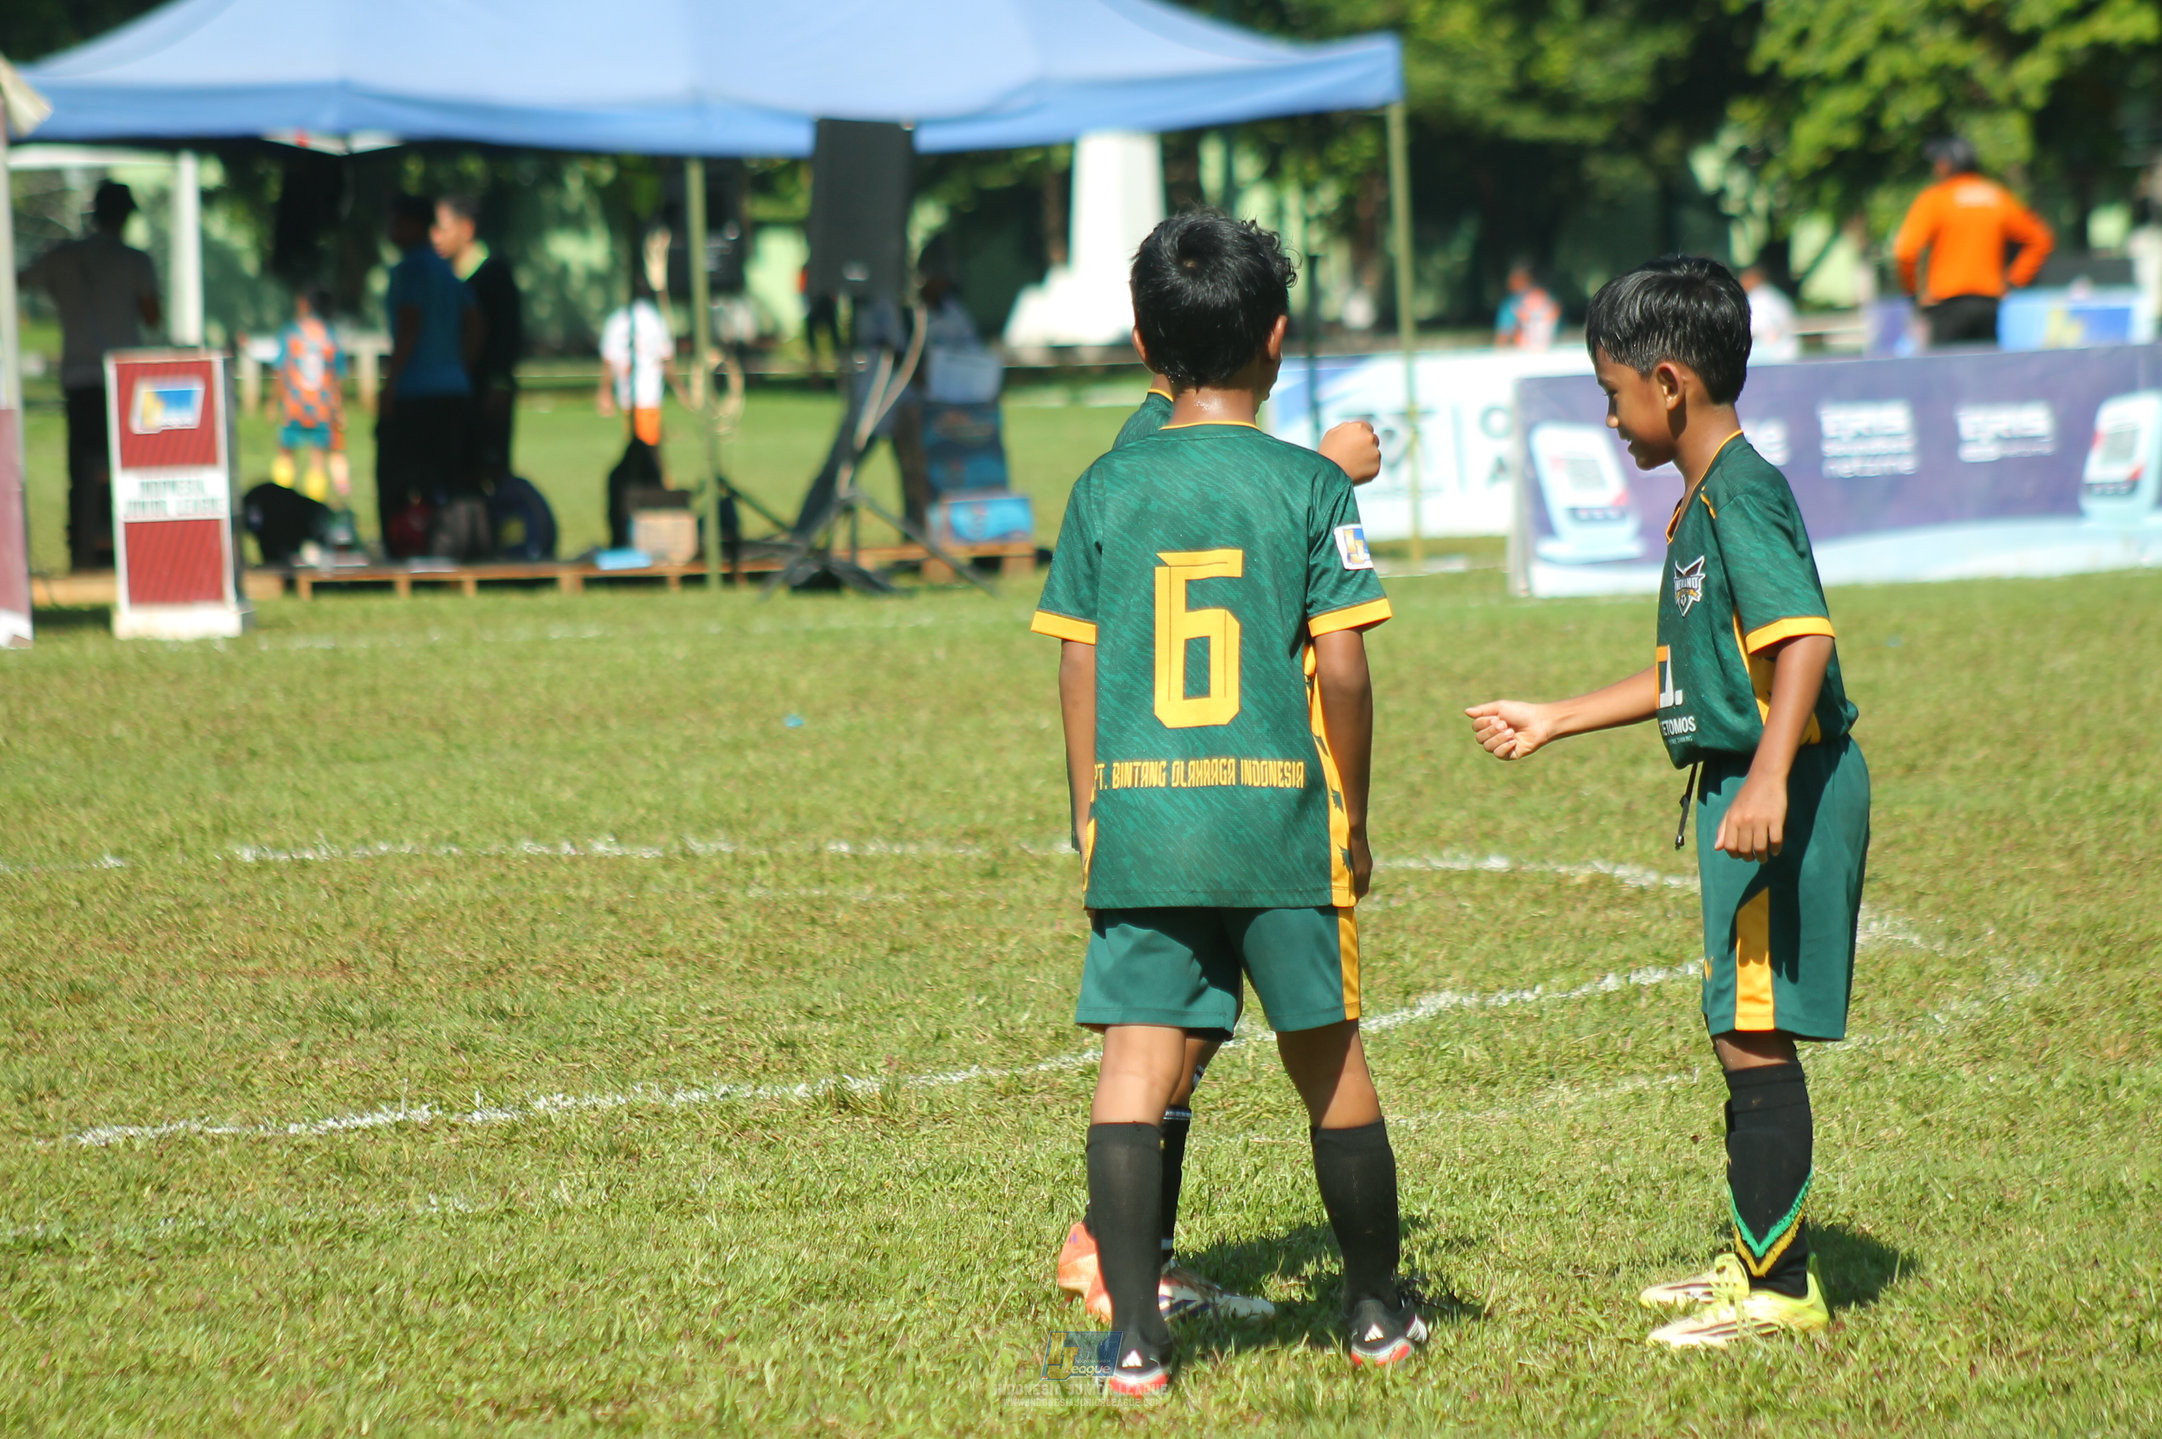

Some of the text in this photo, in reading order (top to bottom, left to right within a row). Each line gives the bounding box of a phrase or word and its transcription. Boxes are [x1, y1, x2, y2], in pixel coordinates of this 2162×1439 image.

[1154, 549, 1243, 728] 6
[1660, 715, 1697, 737] ETOMOS
[1112, 759, 1168, 789] BINTANG
[1171, 758, 1236, 787] OLAHRAGA
[1240, 759, 1305, 788] INDONESIA
